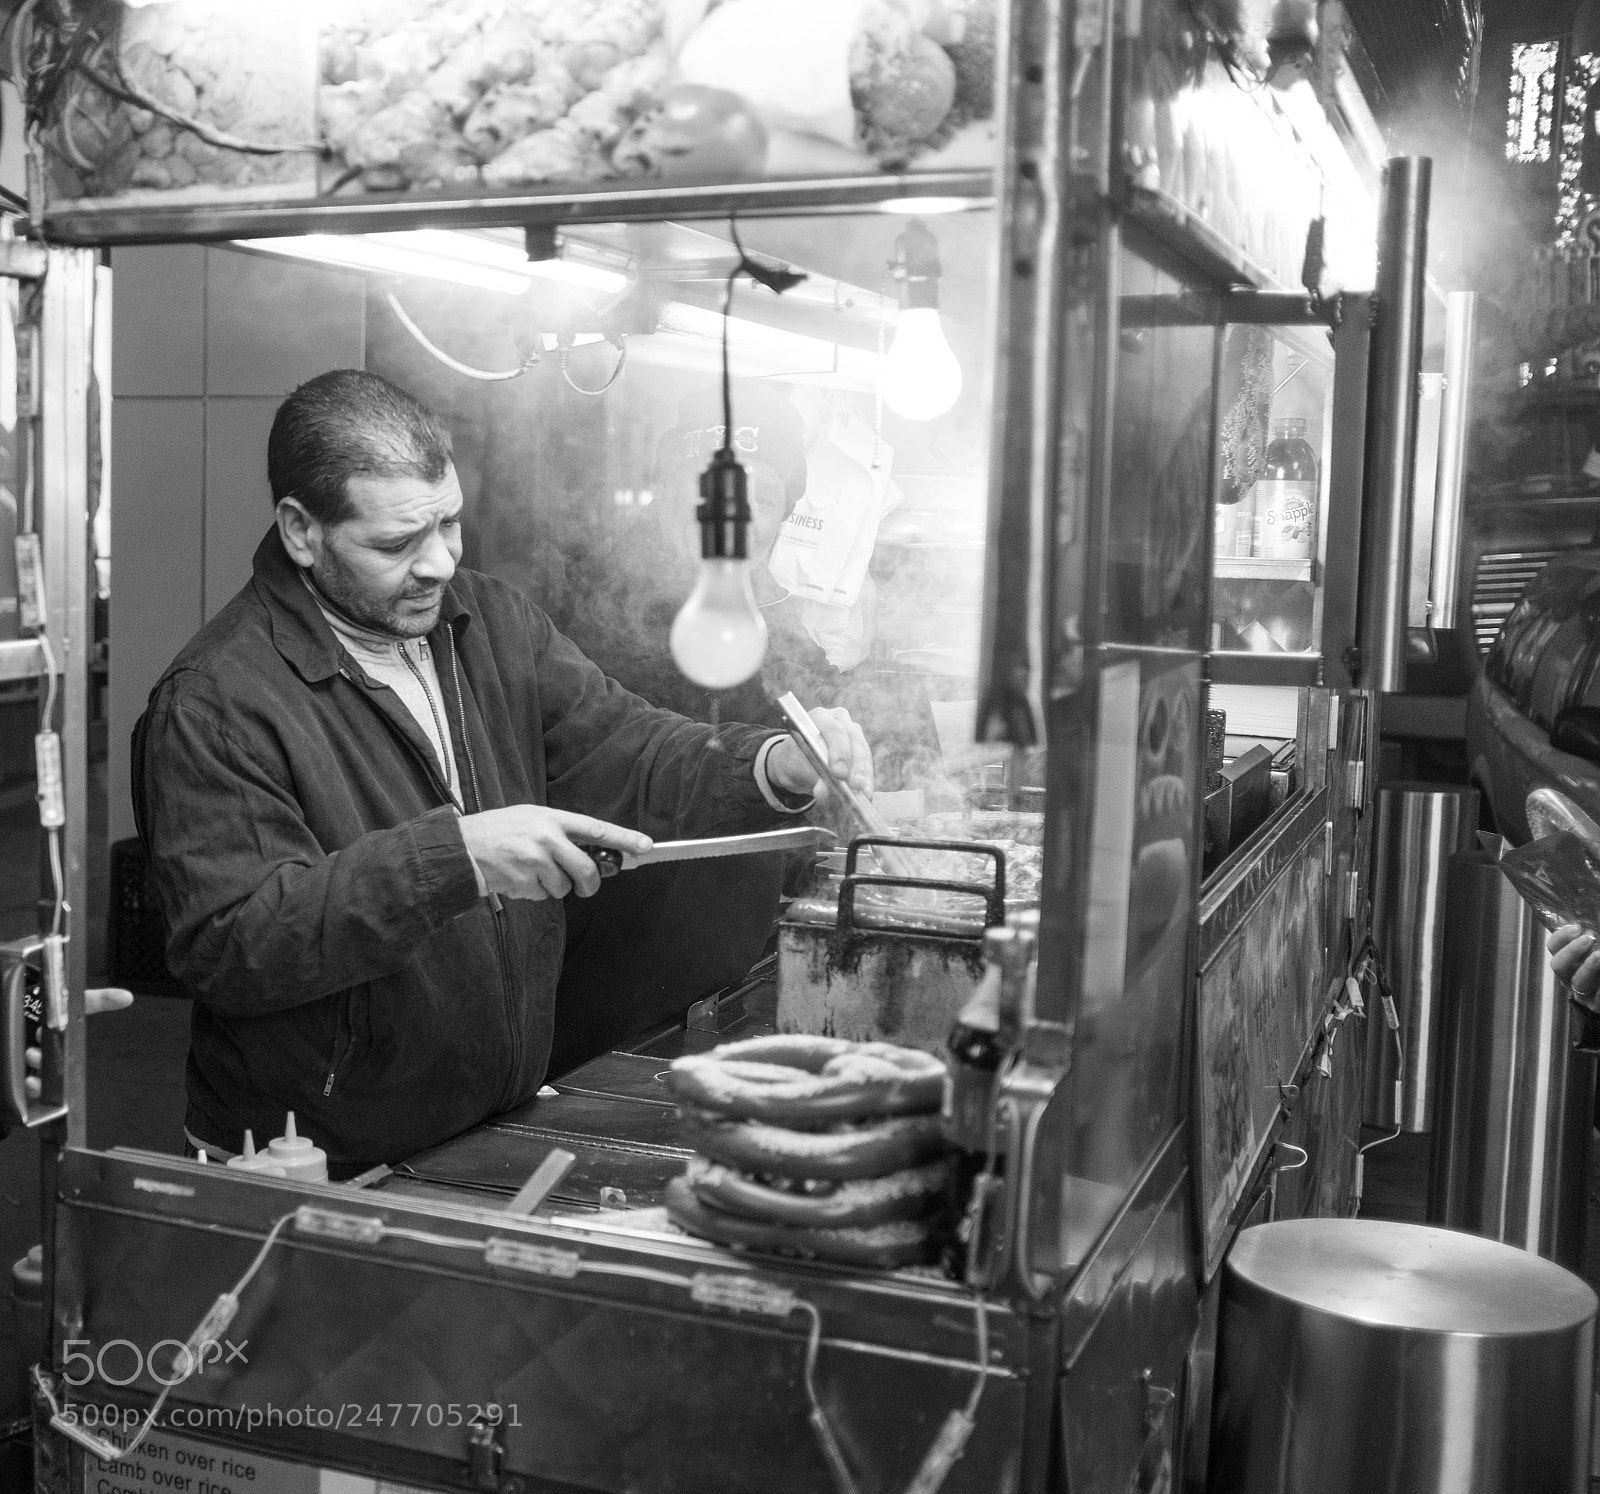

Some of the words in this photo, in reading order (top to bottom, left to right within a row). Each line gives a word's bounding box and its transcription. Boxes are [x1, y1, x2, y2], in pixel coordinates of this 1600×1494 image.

[786, 512, 825, 532] SINESS
[98, 1459, 146, 1481] Lamb
[152, 1470, 192, 1492] over
[175, 1450, 216, 1472] over
[222, 1458, 256, 1481] rice
